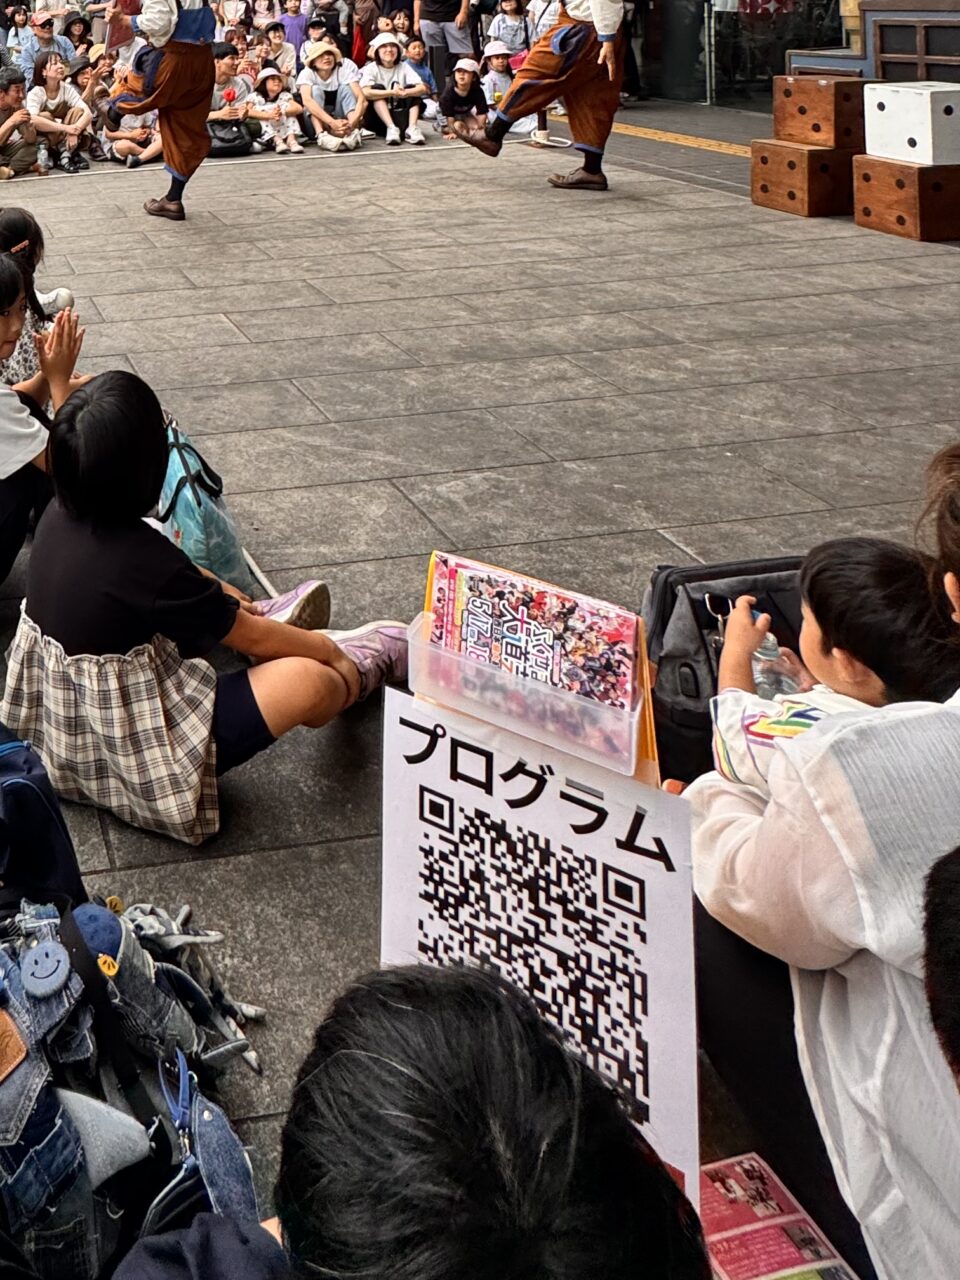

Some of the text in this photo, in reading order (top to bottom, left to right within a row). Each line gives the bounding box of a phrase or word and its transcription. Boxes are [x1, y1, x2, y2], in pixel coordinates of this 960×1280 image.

[398, 716, 676, 872] プログラム
